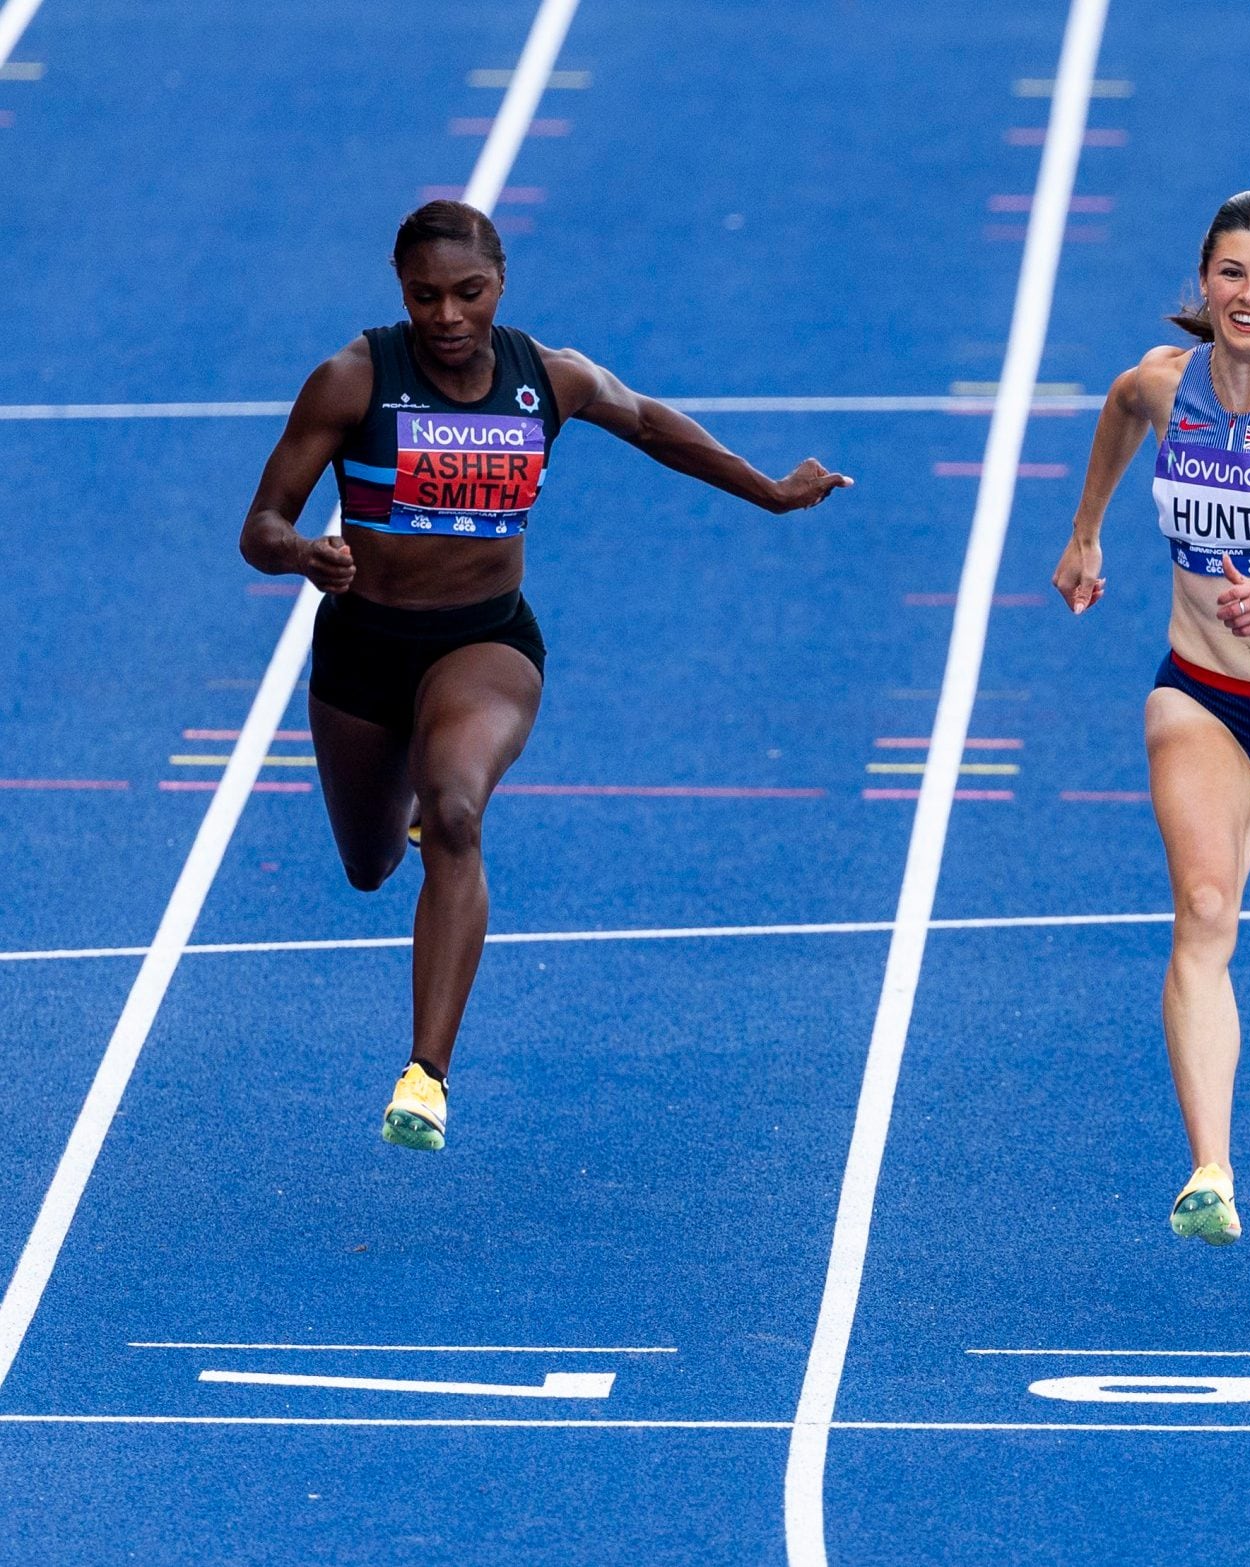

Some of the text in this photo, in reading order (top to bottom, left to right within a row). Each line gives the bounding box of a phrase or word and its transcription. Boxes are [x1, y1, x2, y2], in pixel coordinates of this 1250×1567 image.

[411, 418, 525, 447] Novuna
[414, 453, 529, 481] ASHER
[417, 483, 520, 510] SMITH
[1206, 566, 1225, 574] COC
